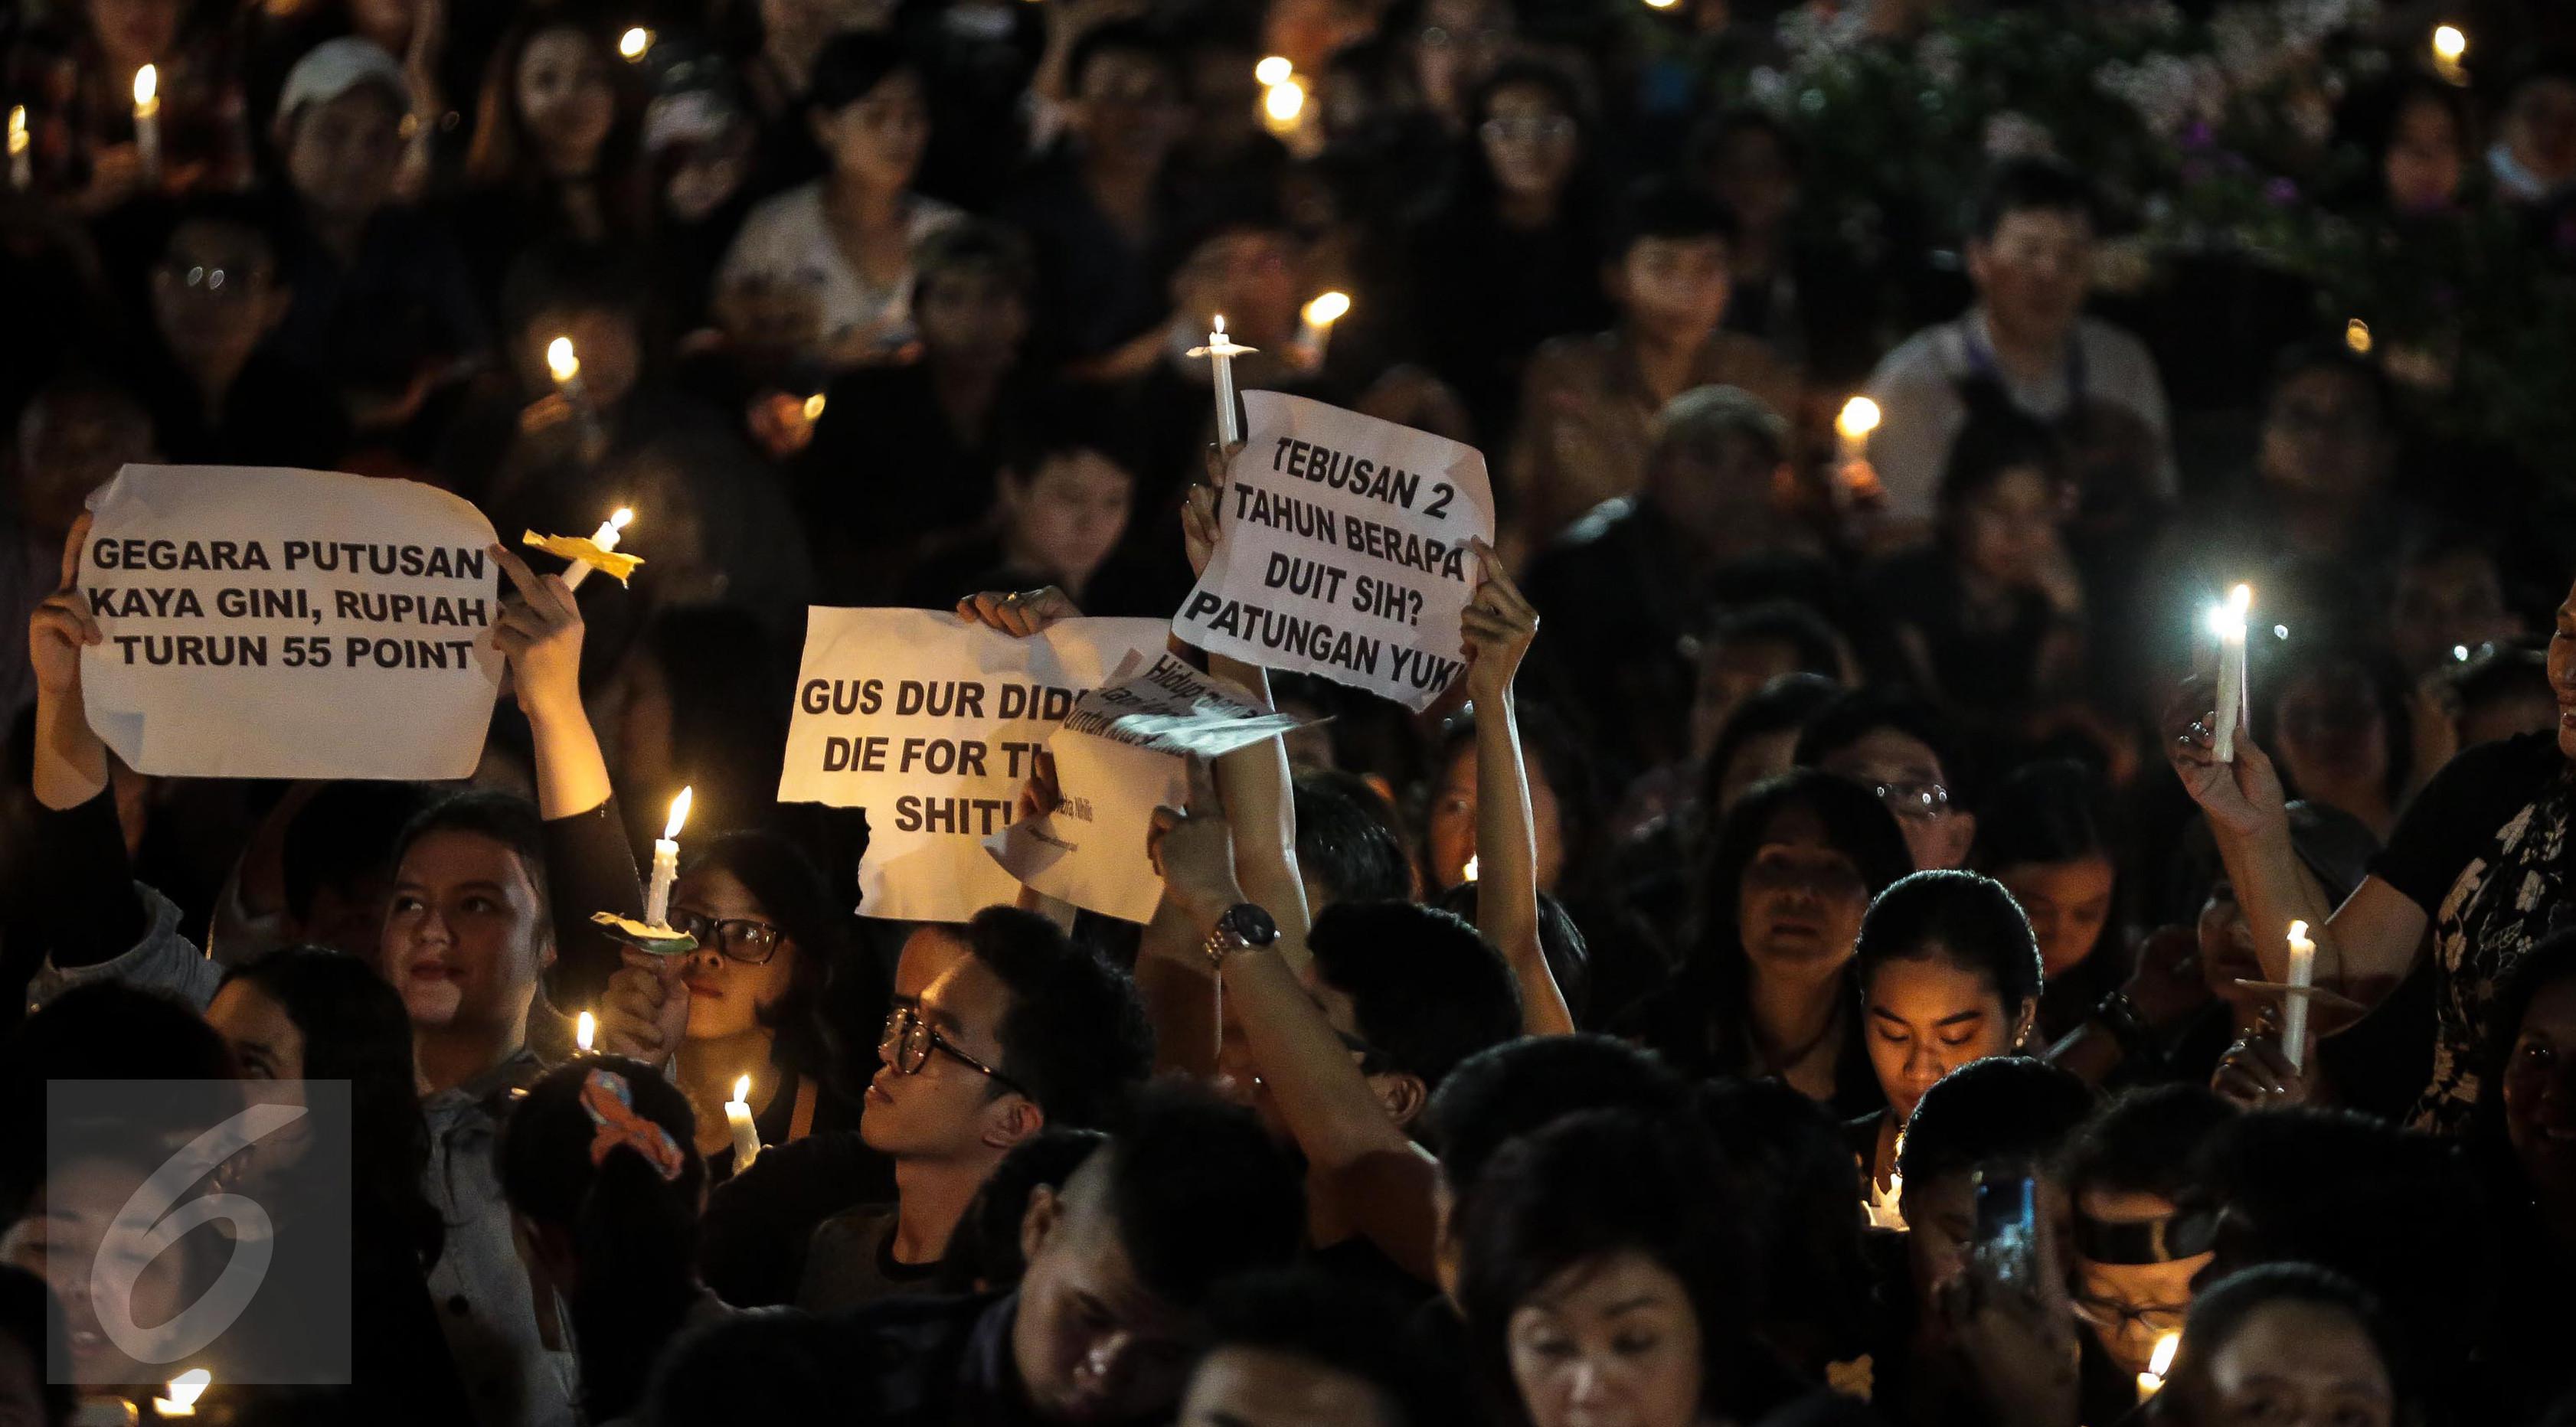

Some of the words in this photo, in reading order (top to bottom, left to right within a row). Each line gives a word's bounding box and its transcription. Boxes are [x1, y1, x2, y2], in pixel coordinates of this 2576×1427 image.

[1273, 436, 1420, 509] TEBUSAN
[1423, 483, 1454, 519] 2
[1234, 482, 1337, 544] TAHUN
[1345, 514, 1465, 582] BERAPA
[93, 538, 270, 570] GEGARA
[284, 541, 483, 579] PUTUSAN
[88, 587, 204, 618] KAYA
[217, 588, 321, 625] GINI,
[335, 590, 488, 626] RUPIAH
[1265, 551, 1346, 603] DUIT
[1352, 576, 1423, 626] SIH?
[113, 636, 266, 666] TURUN
[283, 637, 331, 667] 55
[347, 638, 473, 669] POINT
[1184, 590, 1381, 675] PATUNGAN
[802, 679, 883, 714] GUS
[896, 681, 985, 718] DUR
[823, 736, 889, 772] DIE
[900, 738, 987, 778] FOR
